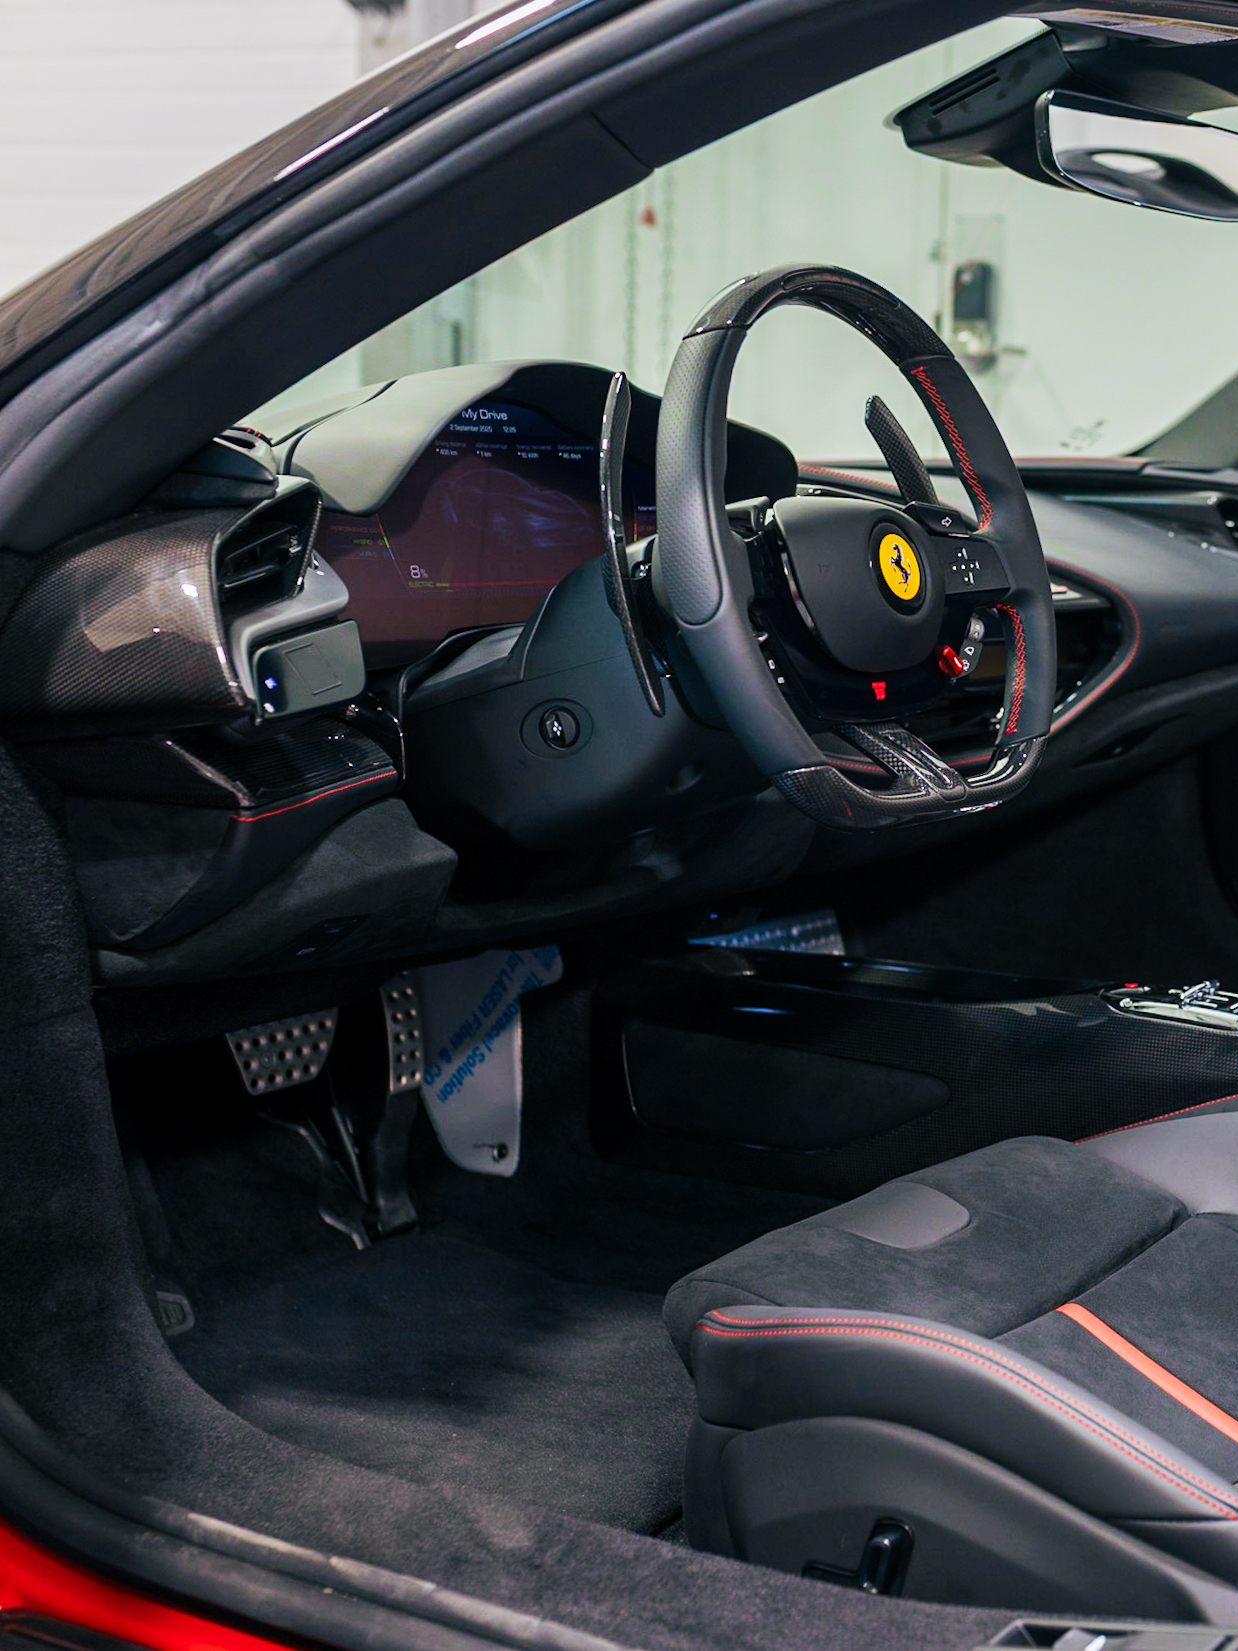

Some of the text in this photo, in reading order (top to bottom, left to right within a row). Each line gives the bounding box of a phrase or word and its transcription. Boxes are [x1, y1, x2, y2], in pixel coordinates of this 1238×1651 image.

[454, 424, 479, 432] September
[462, 408, 508, 421] My Drive
[478, 968, 514, 1018] LASER
[450, 1012, 482, 1049] Fiber
[438, 1047, 453, 1064] &
[436, 1045, 486, 1103] Solution
